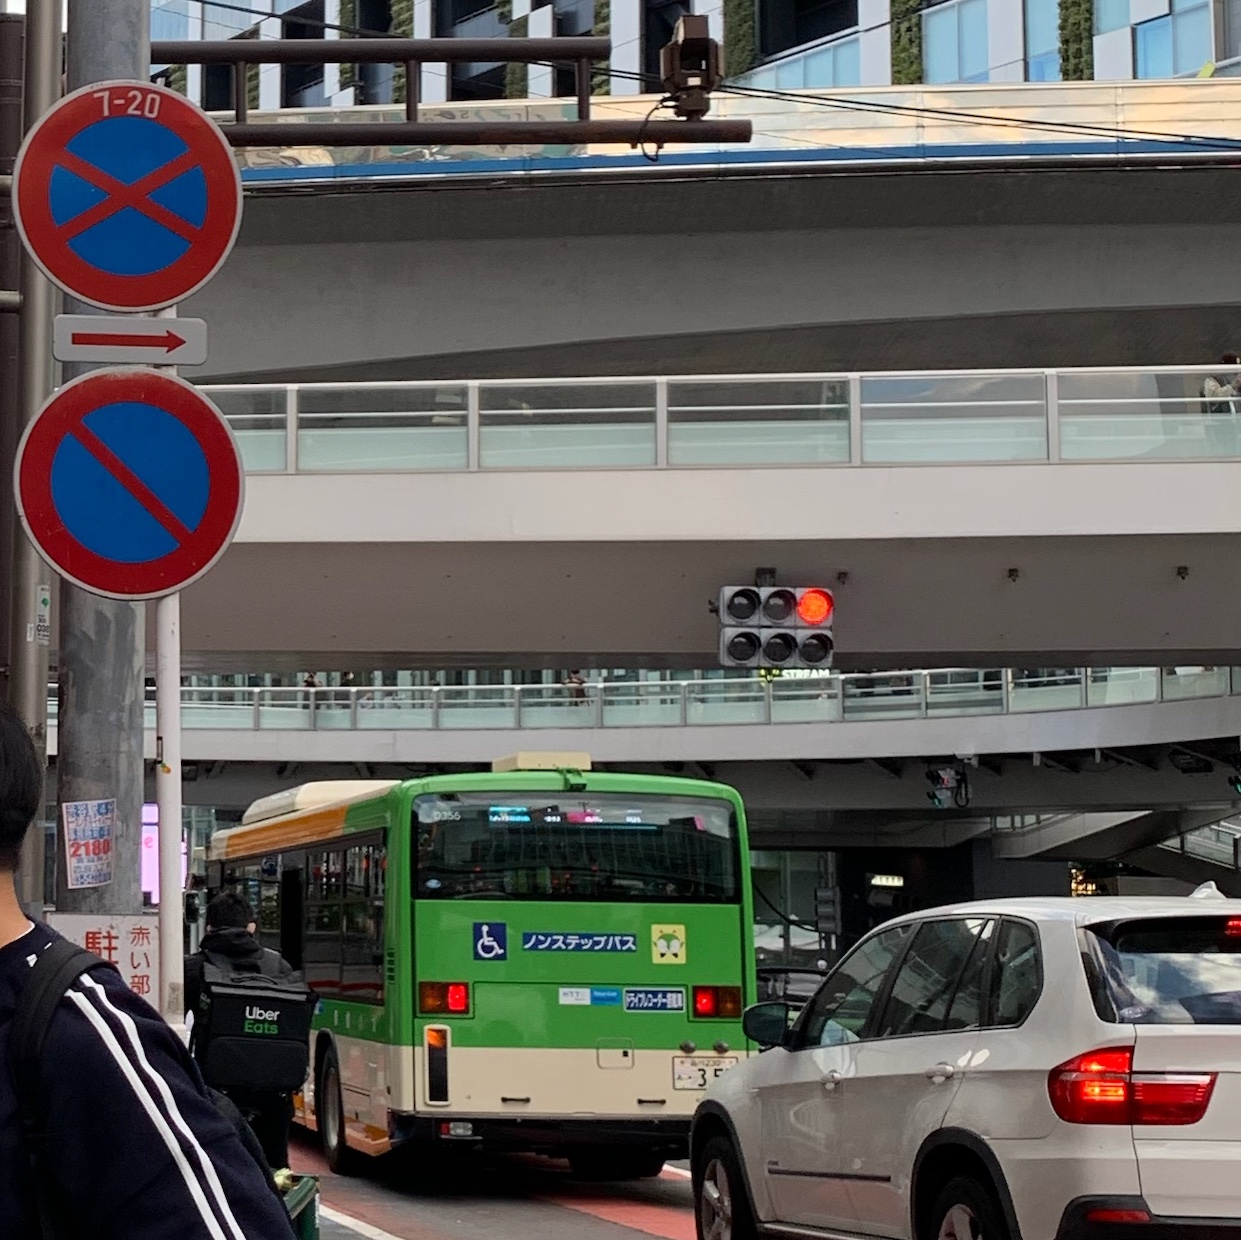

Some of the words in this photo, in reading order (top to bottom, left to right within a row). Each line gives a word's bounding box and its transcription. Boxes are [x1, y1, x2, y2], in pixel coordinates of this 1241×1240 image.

[93, 90, 160, 118] 7-20
[781, 668, 830, 679] STREAM
[70, 839, 110, 858] 2180
[523, 934, 637, 951] ノンステップバス
[130, 925, 151, 995] 赤い部
[245, 1006, 281, 1021] Uber
[244, 1020, 279, 1035] Eats
